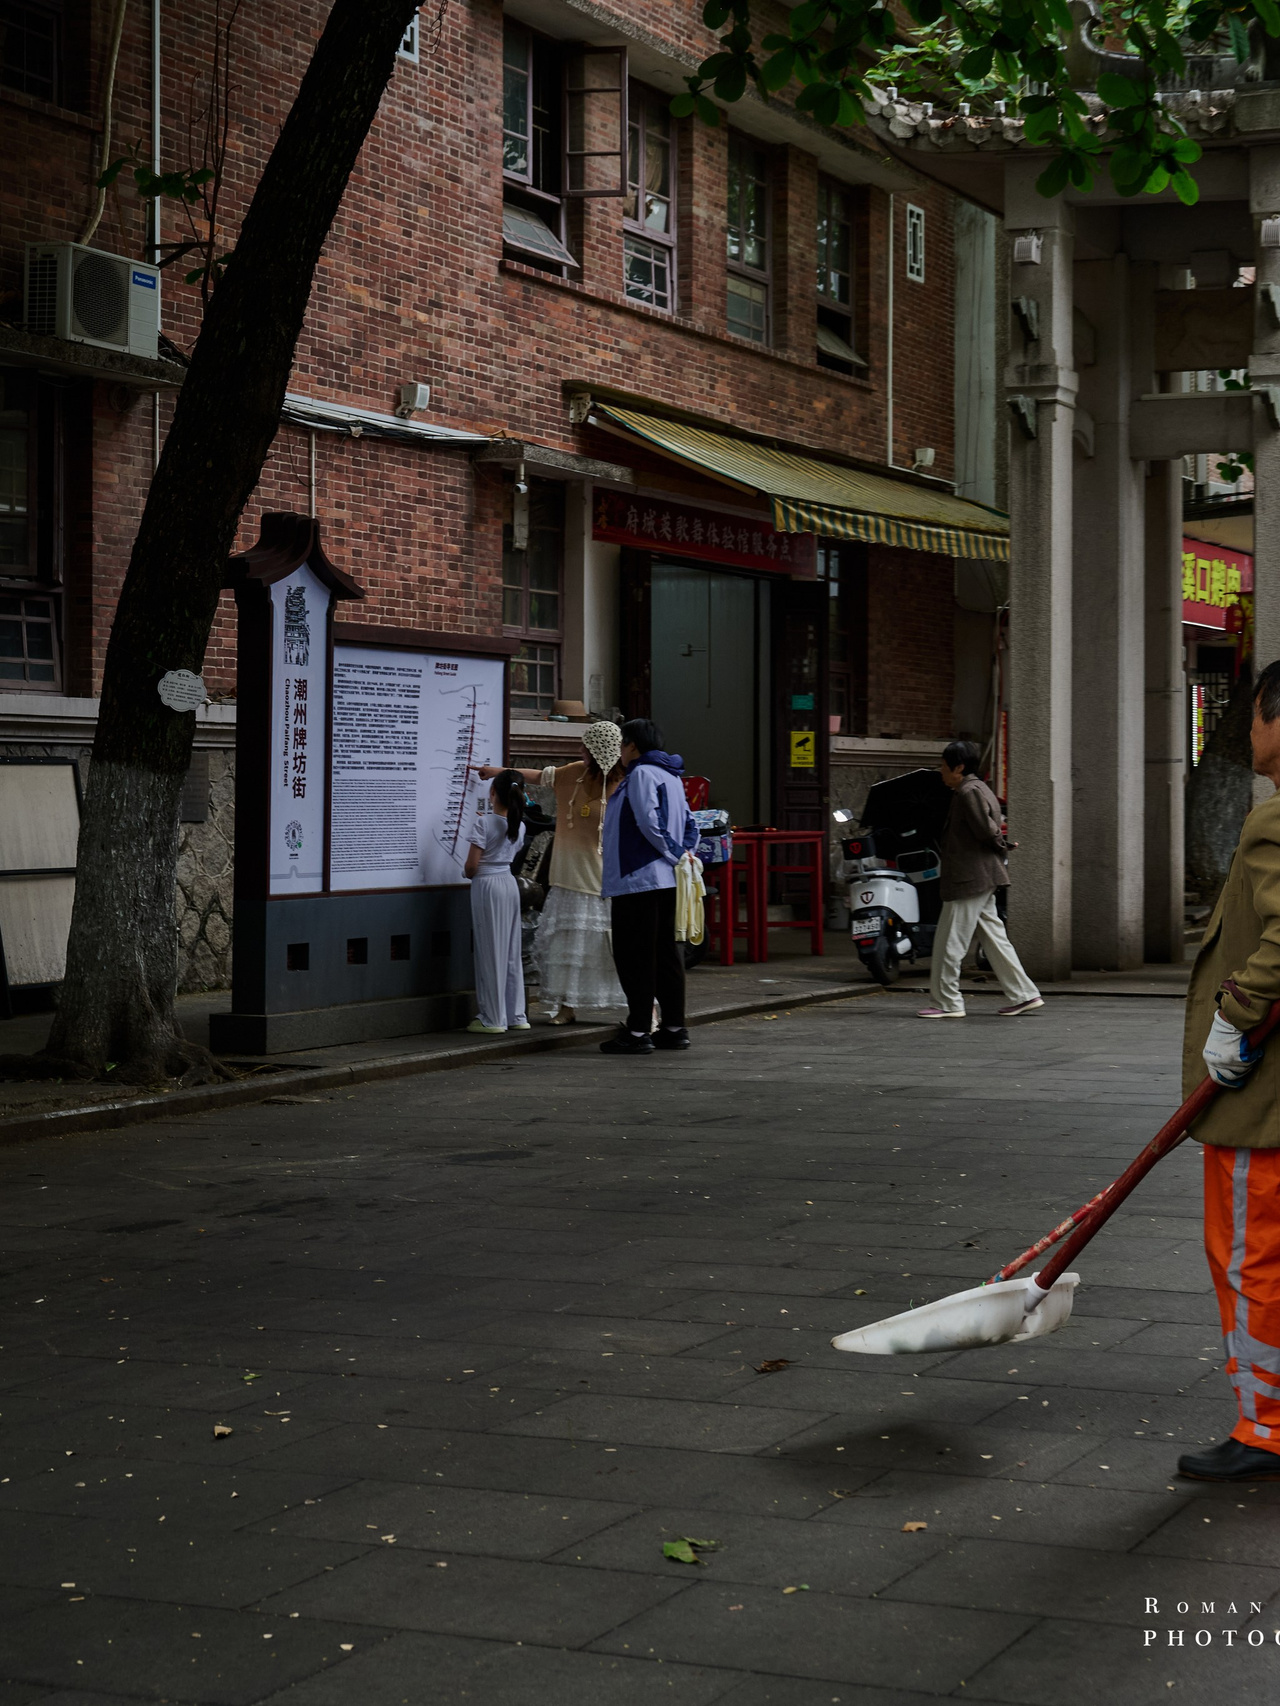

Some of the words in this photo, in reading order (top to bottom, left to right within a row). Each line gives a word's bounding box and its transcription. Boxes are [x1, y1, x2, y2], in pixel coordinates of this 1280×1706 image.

[292, 678, 308, 799] 潮州牌坊街
